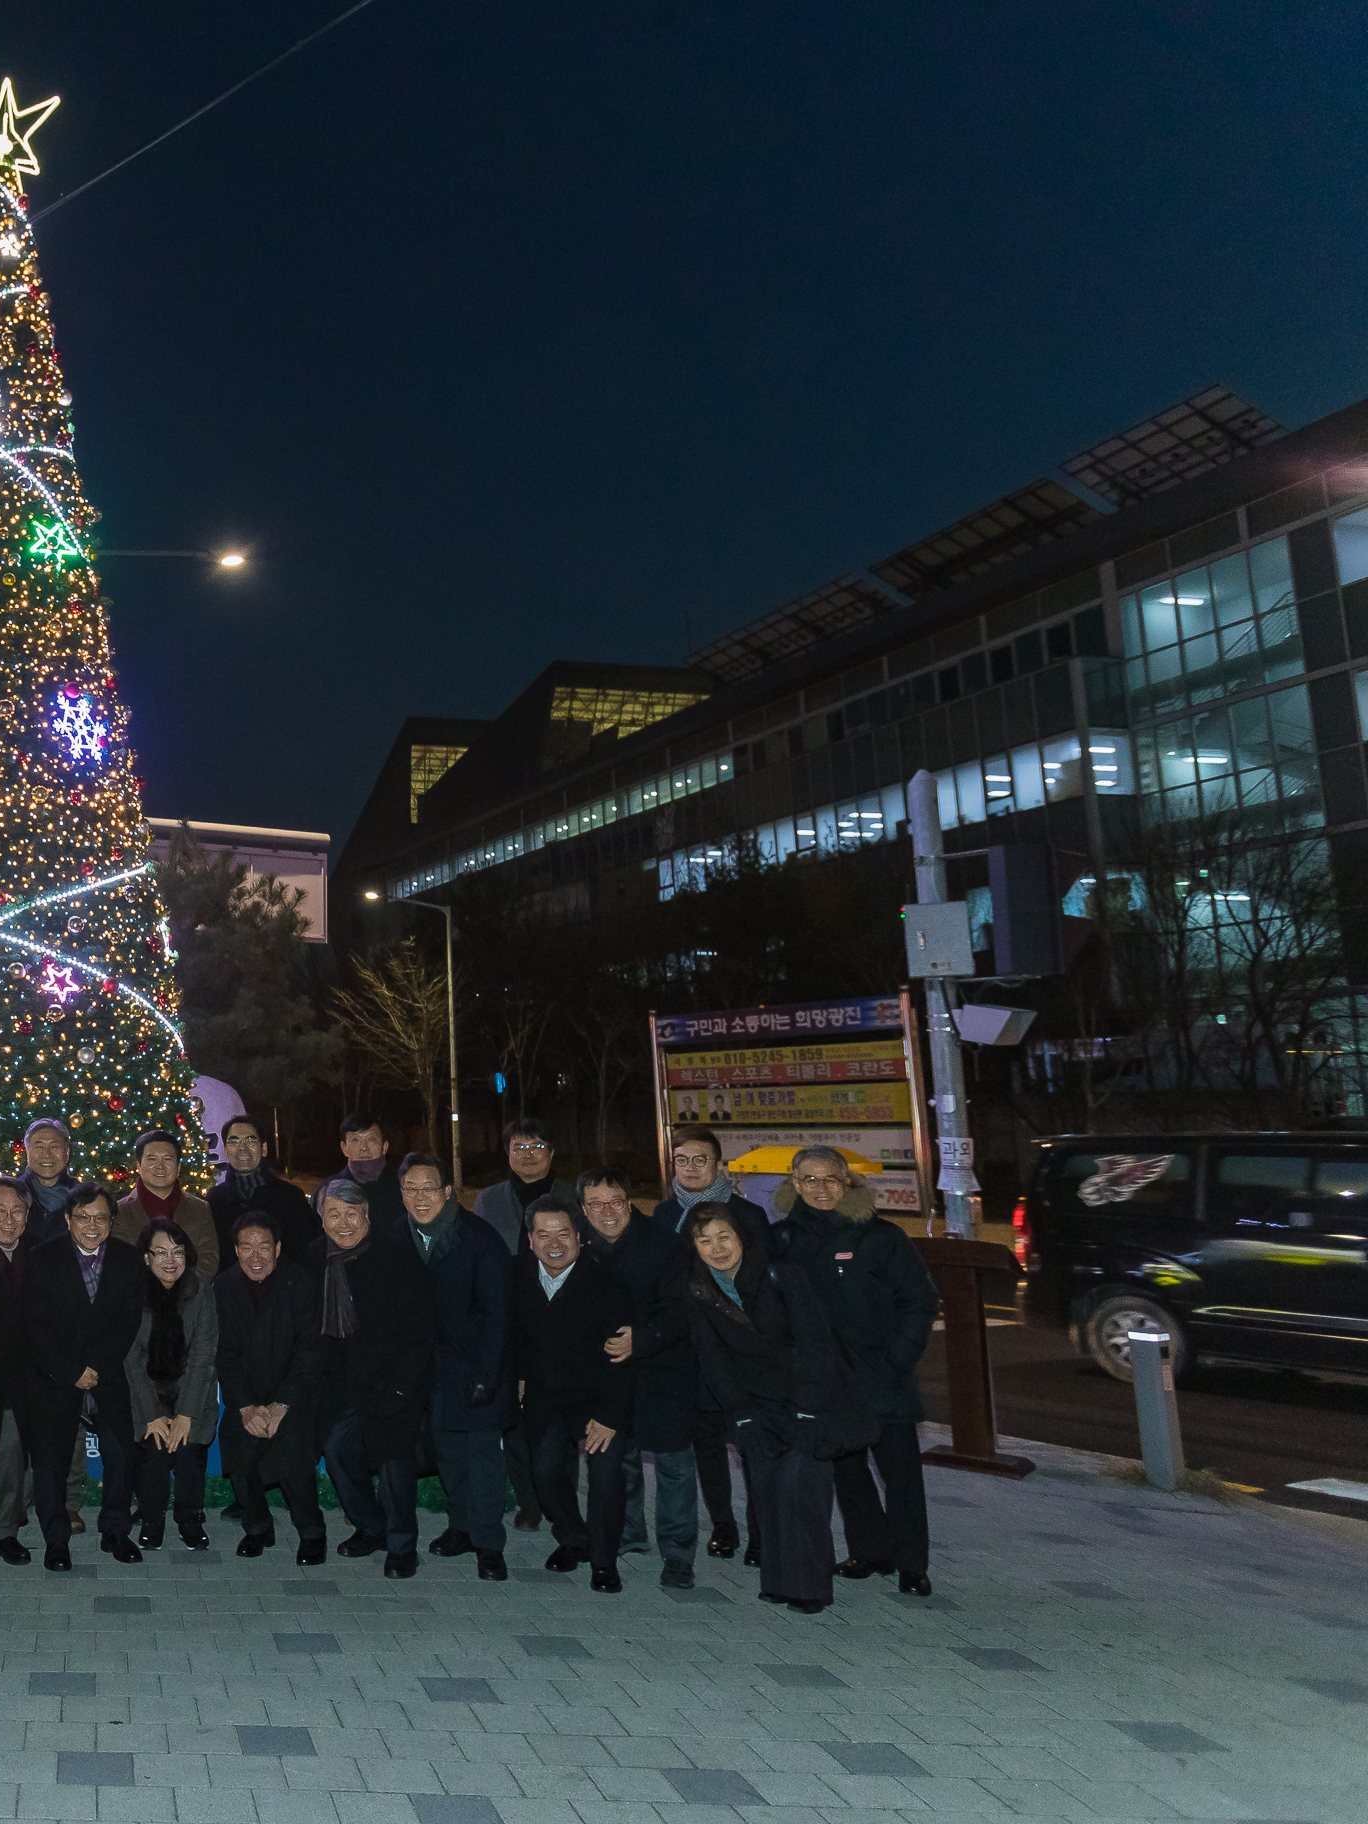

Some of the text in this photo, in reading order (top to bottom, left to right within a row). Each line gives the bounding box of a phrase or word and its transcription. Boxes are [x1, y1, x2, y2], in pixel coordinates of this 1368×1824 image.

[685, 1006, 862, 1037] 구민과 소통하는 희망광진
[846, 1060, 897, 1077] 코란도
